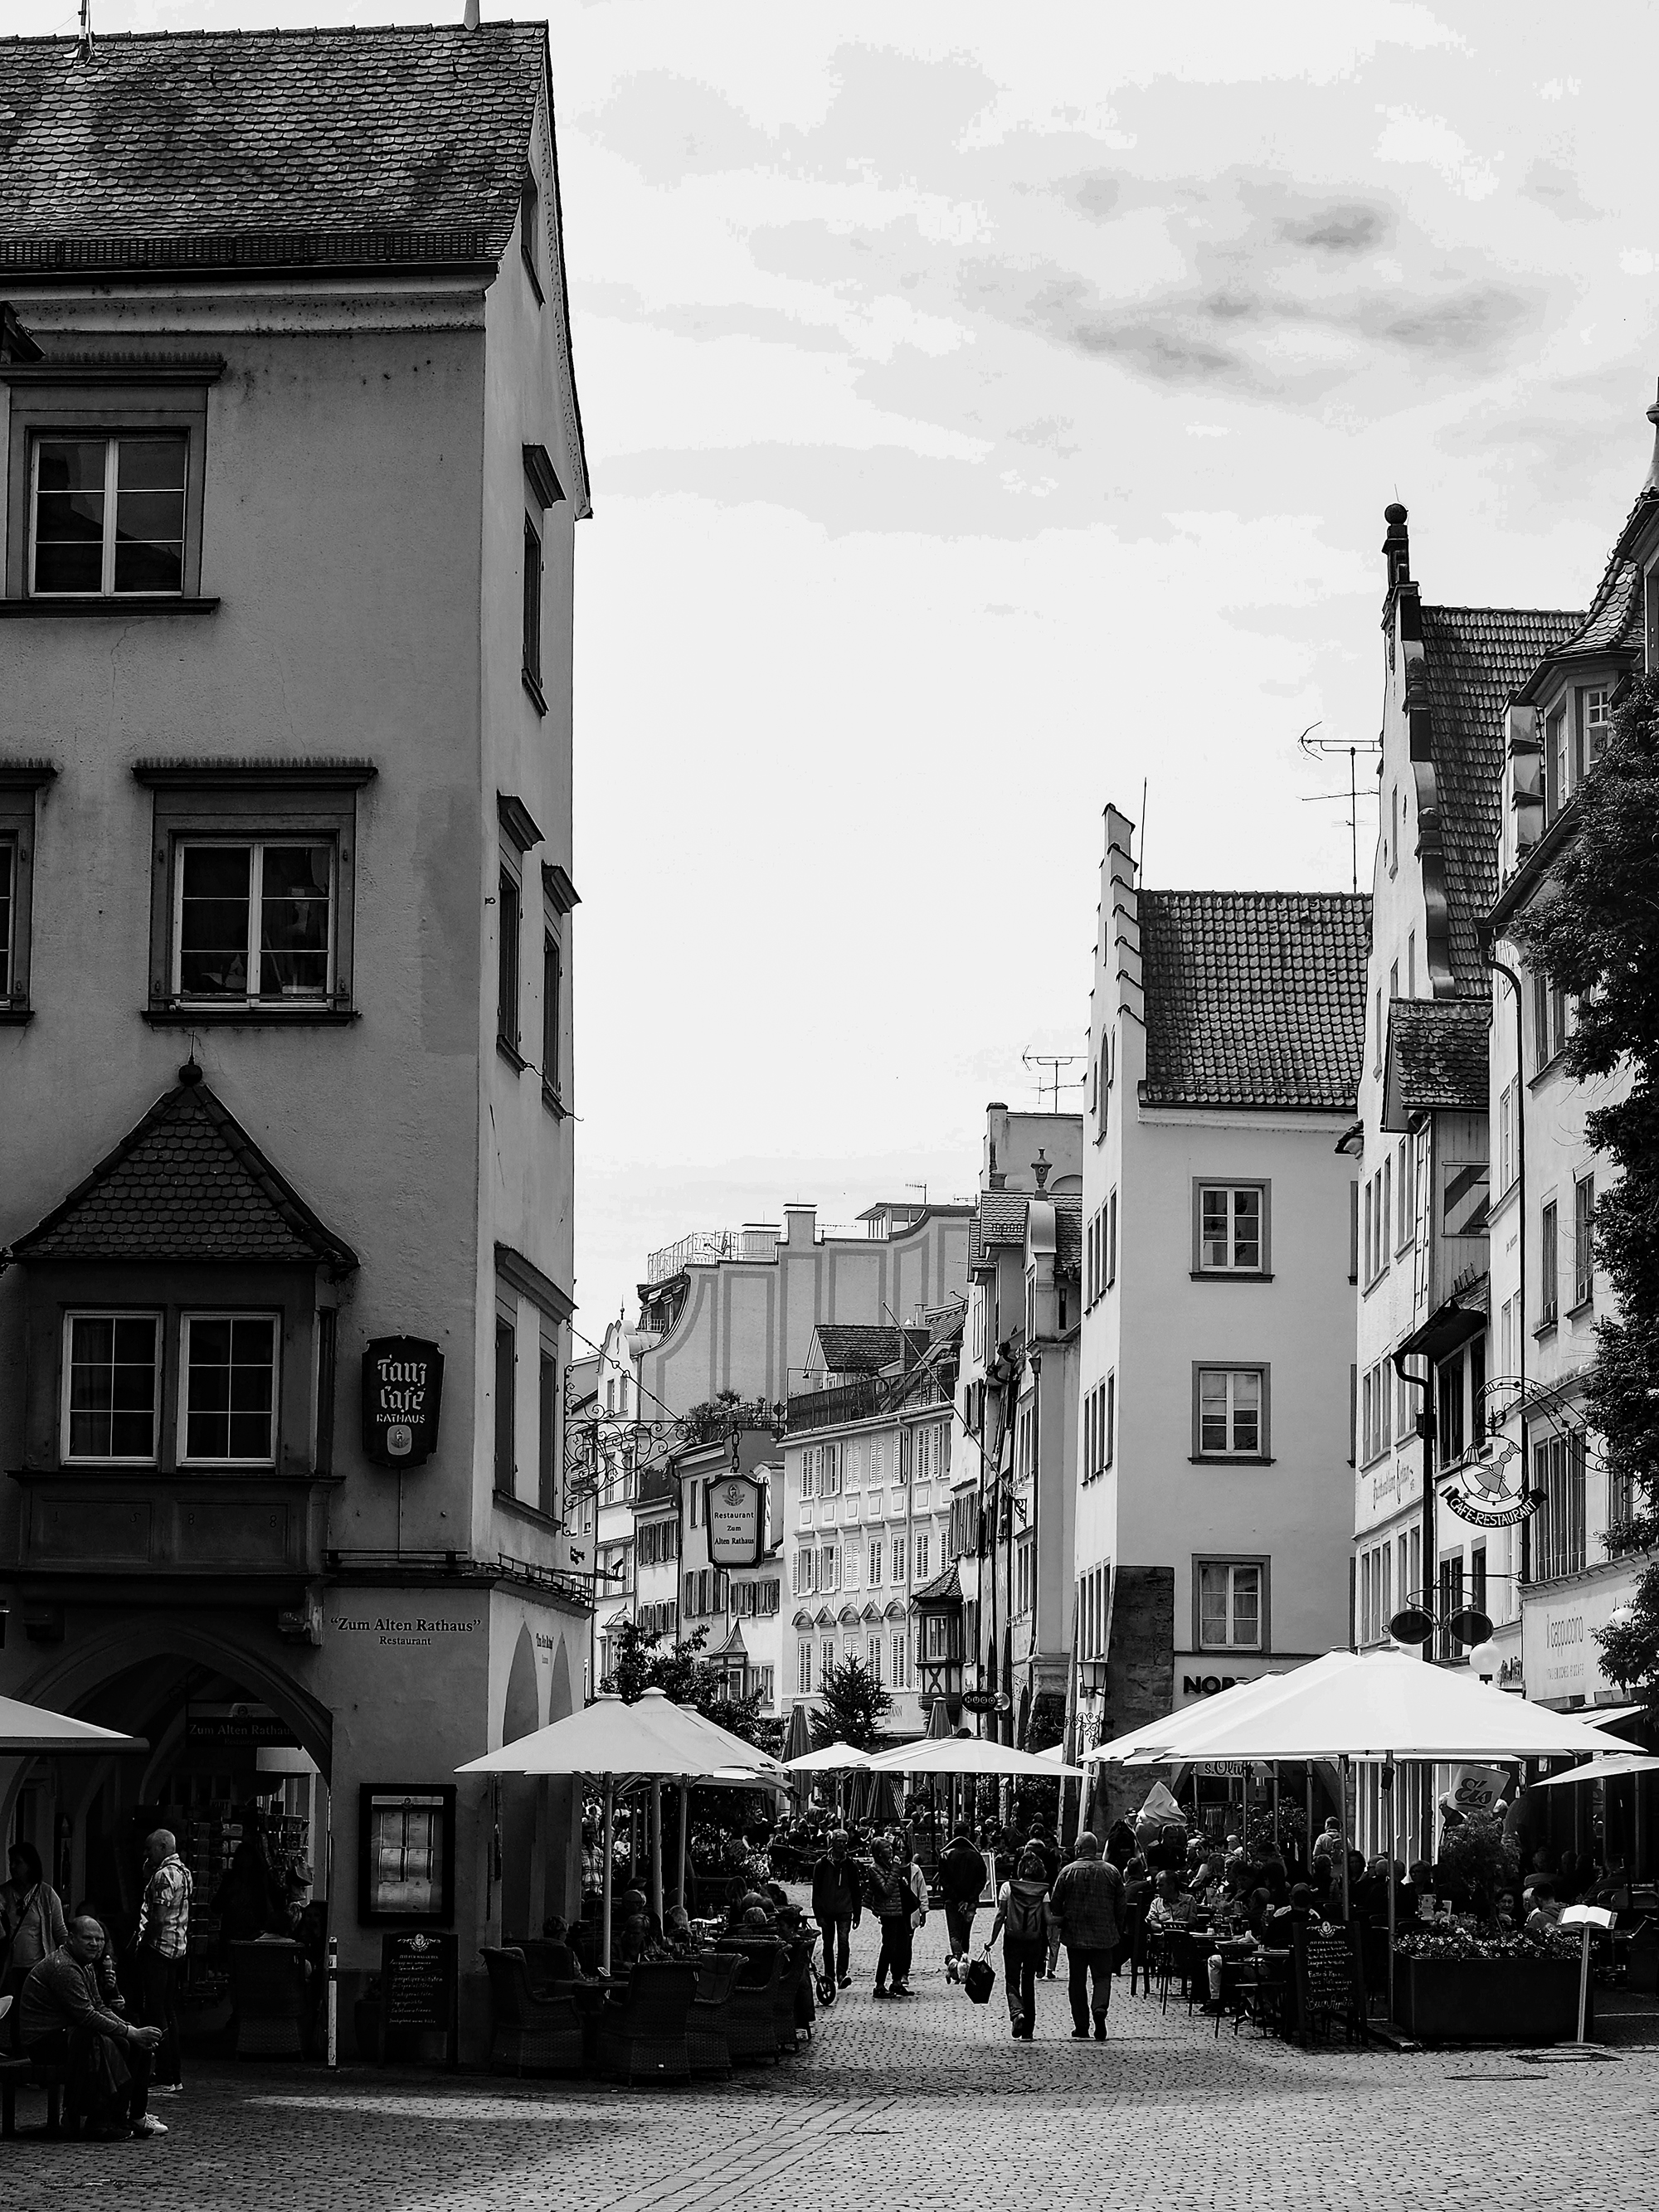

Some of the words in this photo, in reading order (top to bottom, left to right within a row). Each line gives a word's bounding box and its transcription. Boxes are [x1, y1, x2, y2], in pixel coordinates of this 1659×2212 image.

[377, 1413, 426, 1423] RATHAUS
[374, 1618, 412, 1632] Alten
[379, 1636, 431, 1646] Restaurant
[189, 1724, 214, 1735] Zum
[217, 1724, 248, 1735] Alten
[1455, 1777, 1493, 1805] Eis
